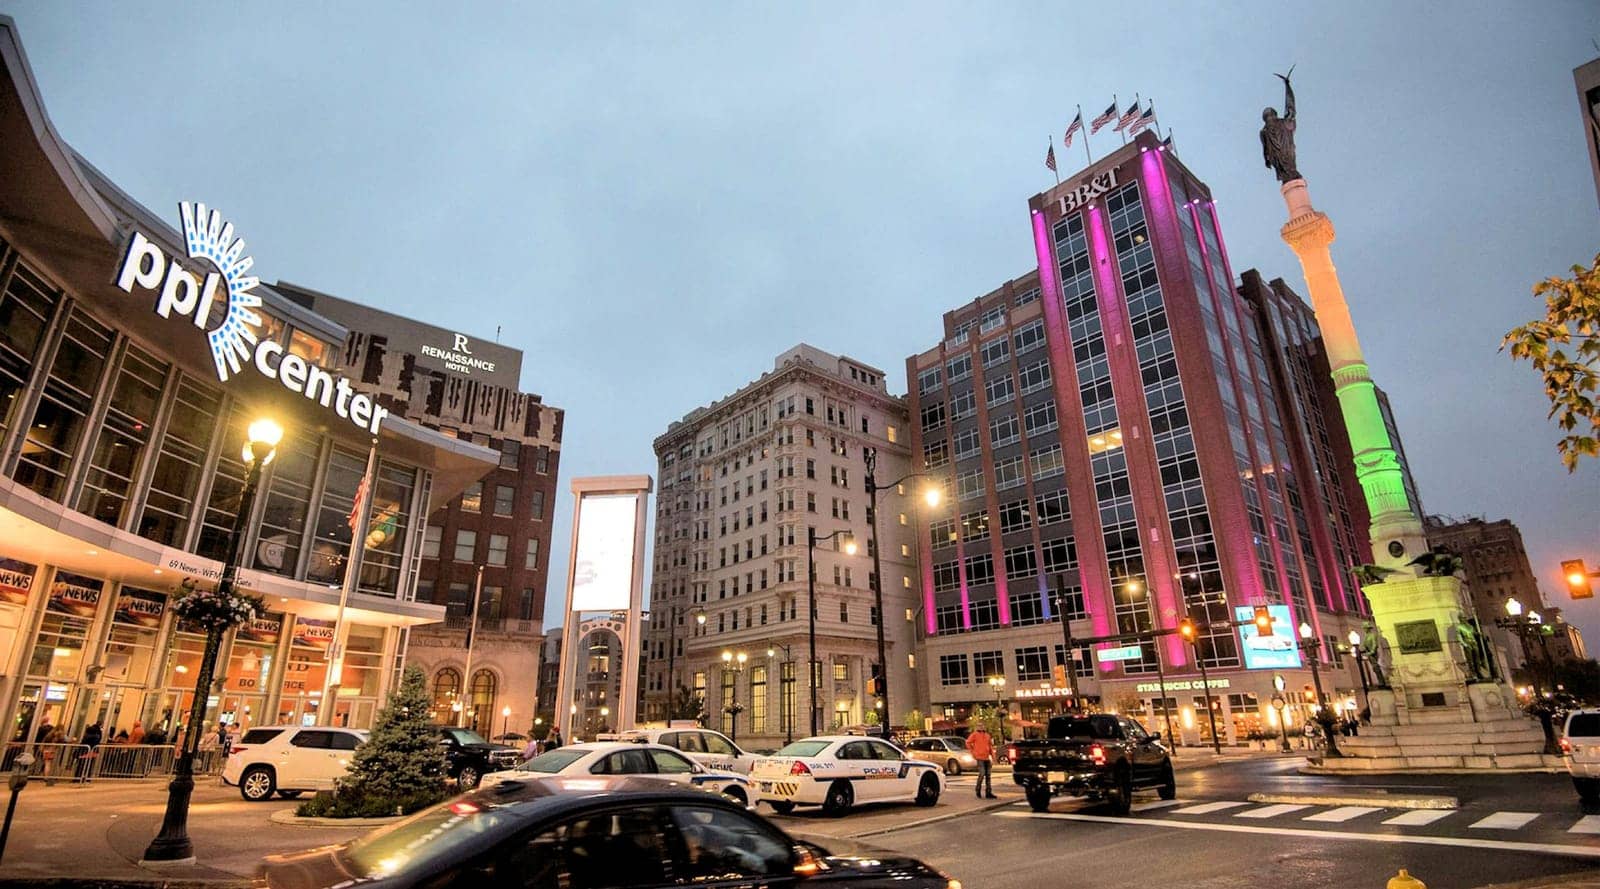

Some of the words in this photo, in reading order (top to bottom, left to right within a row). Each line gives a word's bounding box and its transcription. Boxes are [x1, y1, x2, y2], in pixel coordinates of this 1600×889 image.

[1059, 166, 1121, 215] BB&T
[117, 232, 221, 330] ppl
[452, 333, 472, 354] R
[421, 345, 495, 372] RENAISSANCE
[445, 362, 471, 374] HOTEL
[254, 340, 388, 434] center
[169, 560, 178, 568] 69
[179, 562, 198, 574] News
[202, 568, 221, 580] WFM
[0, 572, 31, 589] NEWS
[64, 587, 98, 603] NEWS
[130, 602, 161, 615] NEWS
[306, 627, 333, 638] NEWS
[239, 679, 256, 688] BO
[1136, 682, 1192, 692] STARUCKS
[863, 767, 897, 775] POLICE
